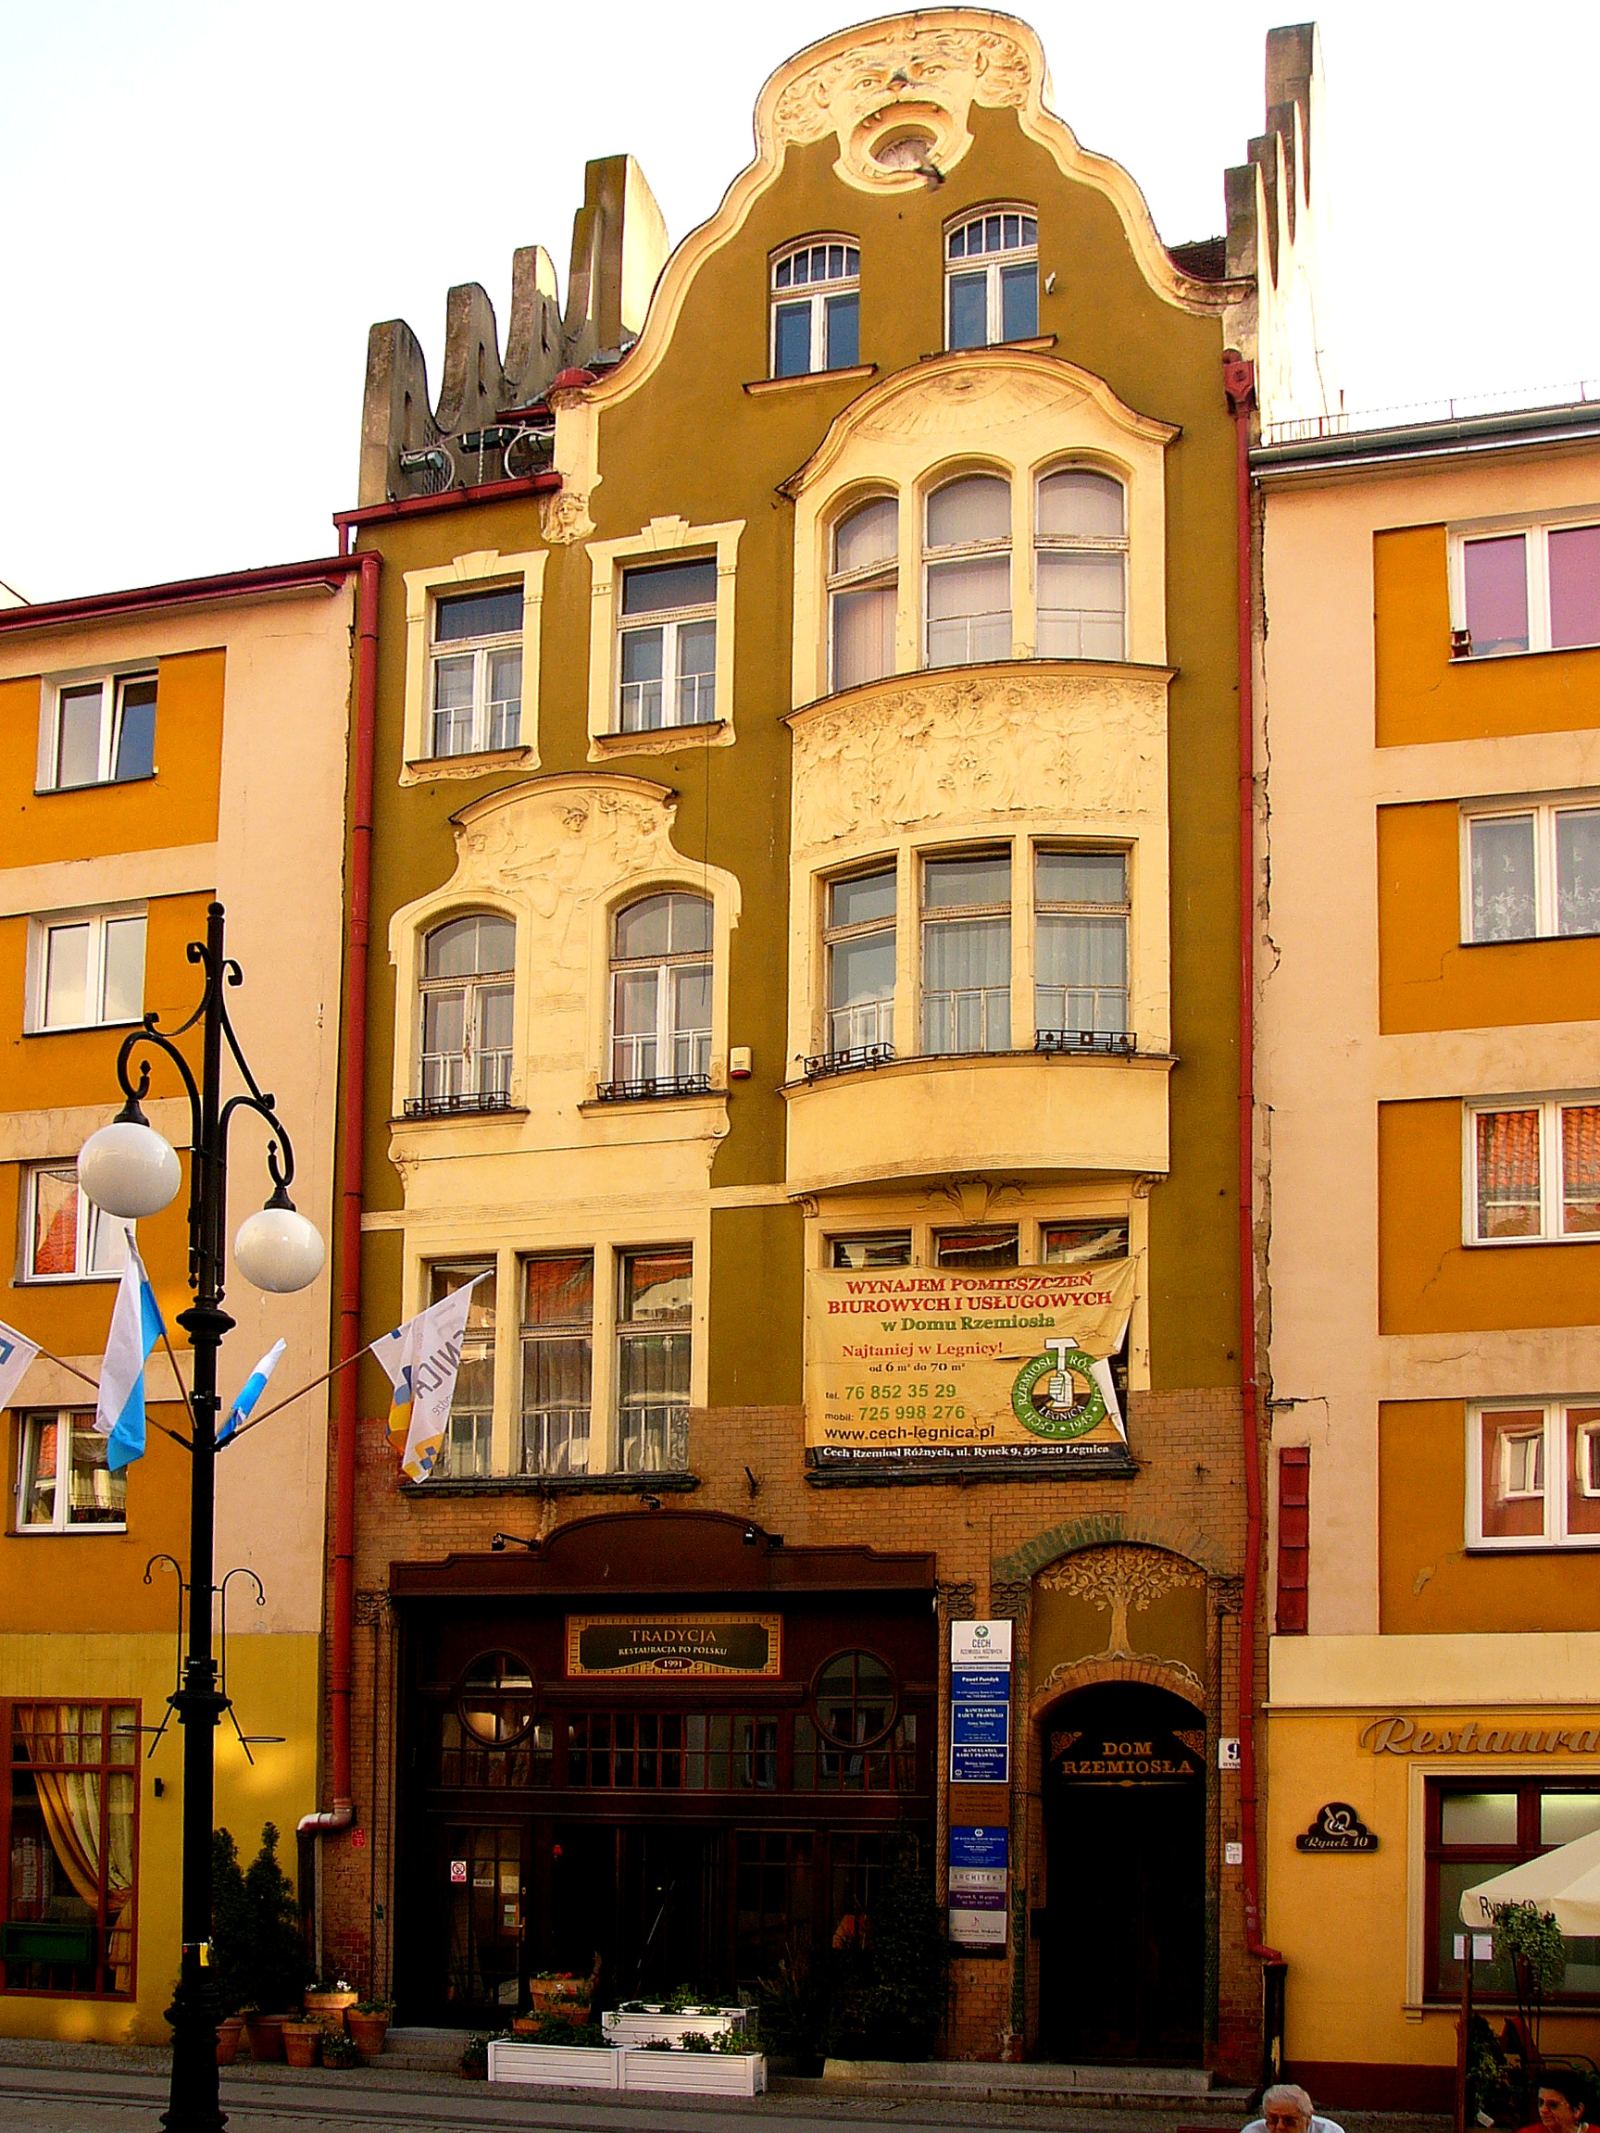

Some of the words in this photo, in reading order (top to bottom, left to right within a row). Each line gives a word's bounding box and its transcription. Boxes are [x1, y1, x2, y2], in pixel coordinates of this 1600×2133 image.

[846, 1278, 945, 1295] WYNAJEM
[950, 1271, 1095, 1292] POMIESZCZEŃ
[828, 1297, 950, 1314] BIUROWYCH
[954, 1297, 963, 1311] I
[967, 1291, 1113, 1311] USŁUGOWYCH
[881, 1319, 897, 1331] w
[901, 1317, 957, 1332] Domu
[961, 1313, 1055, 1330] Rzemiosła
[842, 1342, 914, 1359] Najtaniej
[918, 1346, 932, 1356] w
[936, 1342, 1003, 1357] Legnicy!
[869, 1363, 882, 1372] od
[885, 1361, 894, 1373] 6
[913, 1362, 927, 1371] do
[930, 1362, 948, 1372] 70
[825, 1391, 840, 1400] tel.
[845, 1386, 865, 1400] 76
[871, 1385, 902, 1399] 852
[908, 1384, 929, 1398] 35
[935, 1384, 956, 1398] 29
[824, 1412, 854, 1422] mobil:
[859, 1407, 889, 1421] 725
[896, 1406, 926, 1420] 998
[933, 1405, 965, 1419] 276
[1038, 1404, 1085, 1421] LEGNICA
[824, 1425, 995, 1442] www.cech-legnica.pl
[823, 1447, 850, 1458] Cech
[903, 1447, 954, 1458] Różnych,
[956, 1447, 970, 1456] ul.
[974, 1446, 1009, 1457] Rynek
[1010, 1446, 1021, 1456] 9,
[1023, 1445, 1063, 1456] 59-220
[1066, 1444, 1109, 1456] Legnica
[630, 1629, 717, 1643] TRADYCJA
[618, 1646, 676, 1655] RESTAURACJA
[678, 1645, 691, 1653] PO
[693, 1646, 728, 1656] POLSKU
[663, 1660, 683, 1668] 1991
[1360, 1716, 1600, 1755] Restaura
[1102, 1742, 1153, 1756] DOM
[1227, 1743, 1240, 1760] 9
[1062, 1760, 1195, 1774] RZEMIOSŁA
[1304, 1836, 1349, 1849] Rynek
[1353, 1836, 1369, 1847] 10
